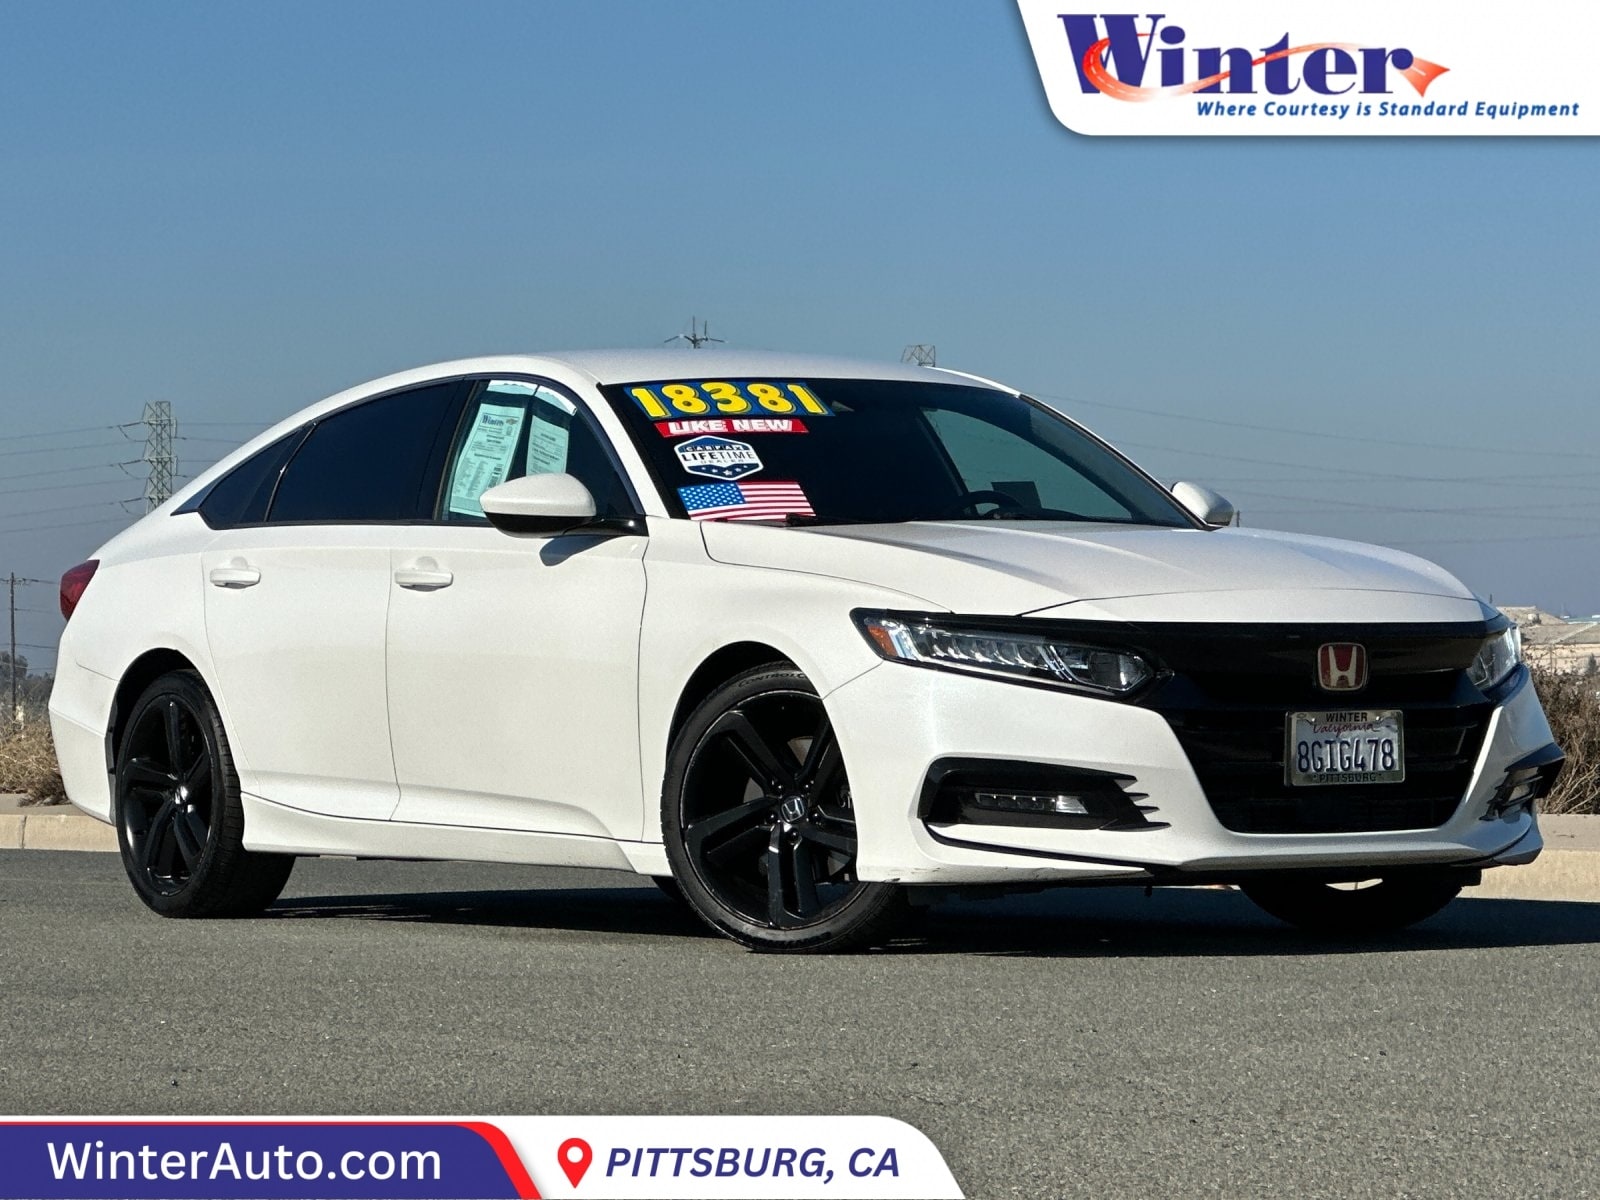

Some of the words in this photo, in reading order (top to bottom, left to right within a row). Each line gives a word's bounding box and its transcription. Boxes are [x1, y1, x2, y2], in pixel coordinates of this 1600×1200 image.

[631, 381, 826, 418] 18381
[667, 418, 728, 435] LIKE
[732, 417, 793, 433] NEW
[681, 450, 756, 462] LIFETIME
[1326, 711, 1369, 723] WINTER
[1312, 721, 1380, 738] California
[1297, 739, 1395, 773] 8GIG478
[1319, 772, 1378, 783] PITTSBURG
